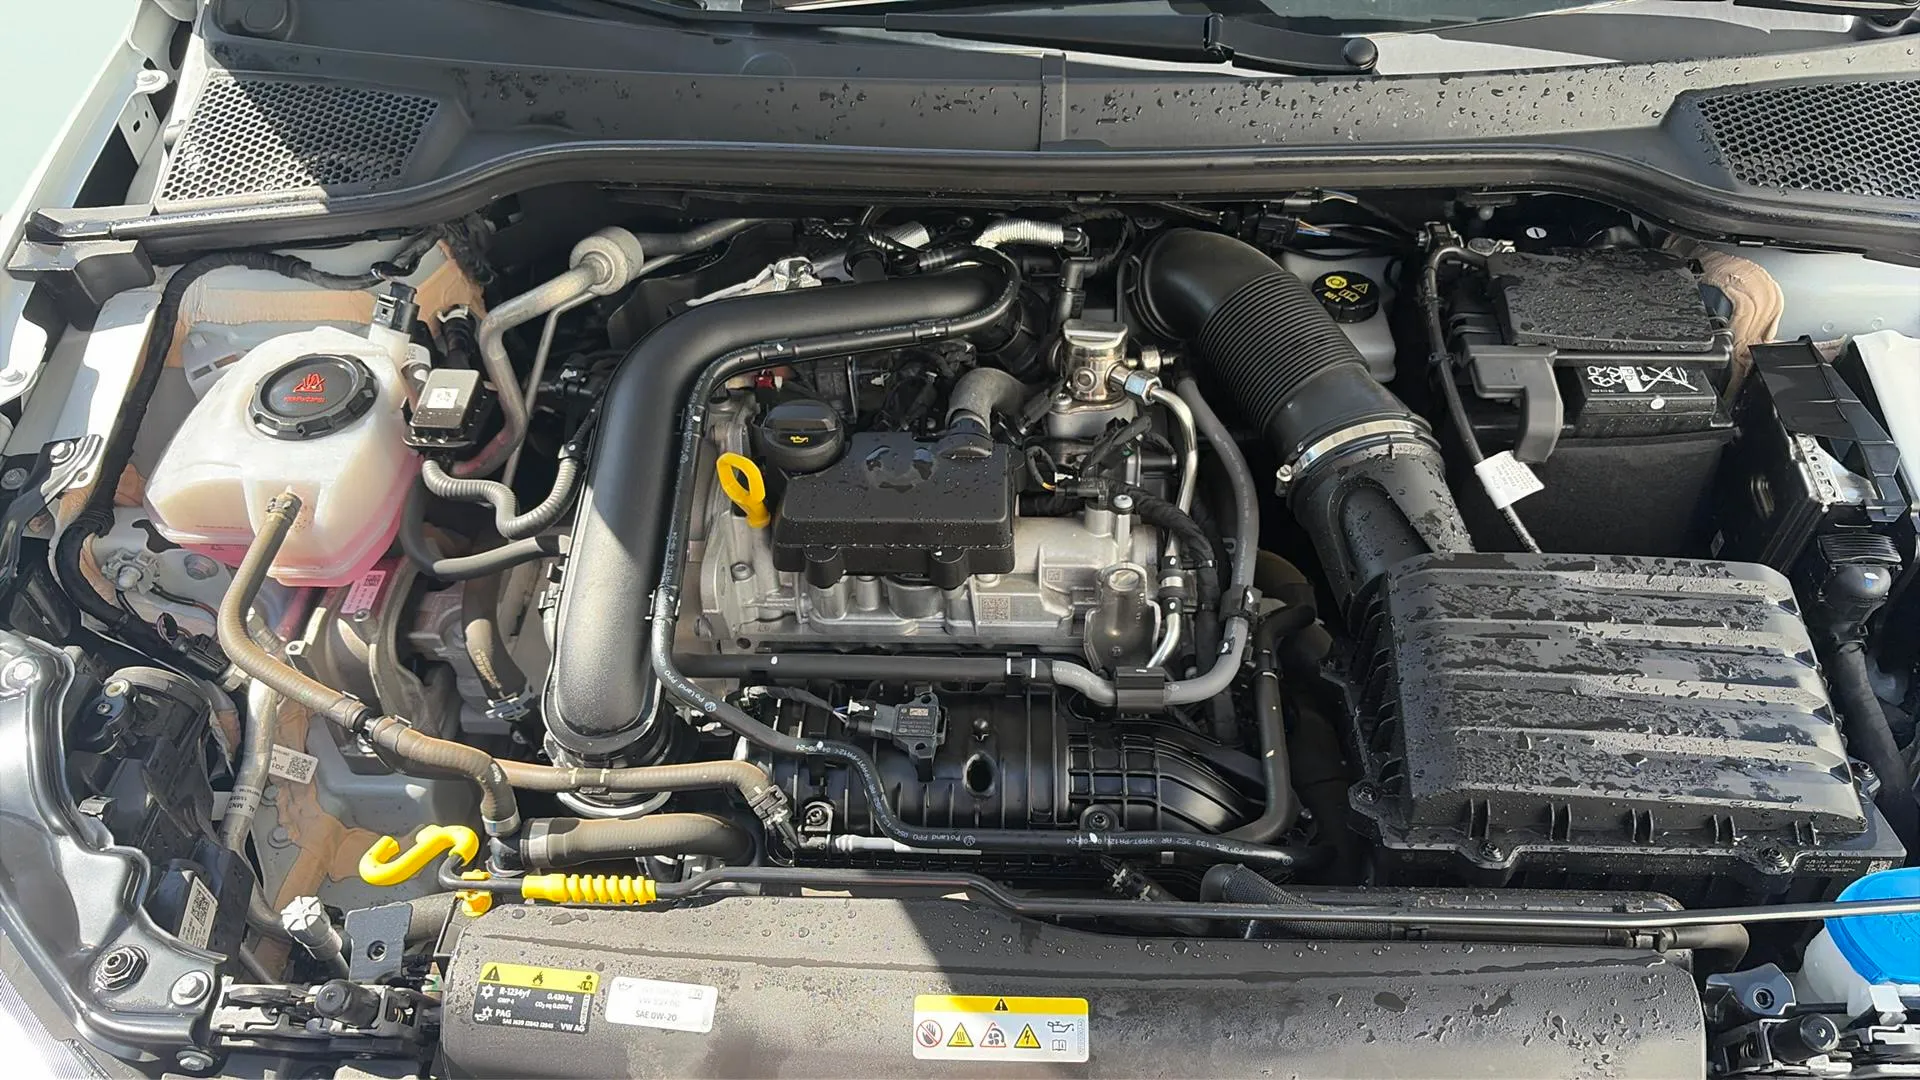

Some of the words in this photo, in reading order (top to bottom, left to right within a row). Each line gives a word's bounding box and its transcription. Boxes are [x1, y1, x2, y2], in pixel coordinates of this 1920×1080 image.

[677, 683, 705, 703] Poland
[931, 834, 961, 842] Poland
[499, 986, 531, 999] R-1234yf
[495, 1008, 512, 1018] PAG
[635, 1009, 649, 1019] SAE
[560, 1022, 574, 1031] VW
[573, 1024, 586, 1032] AG
